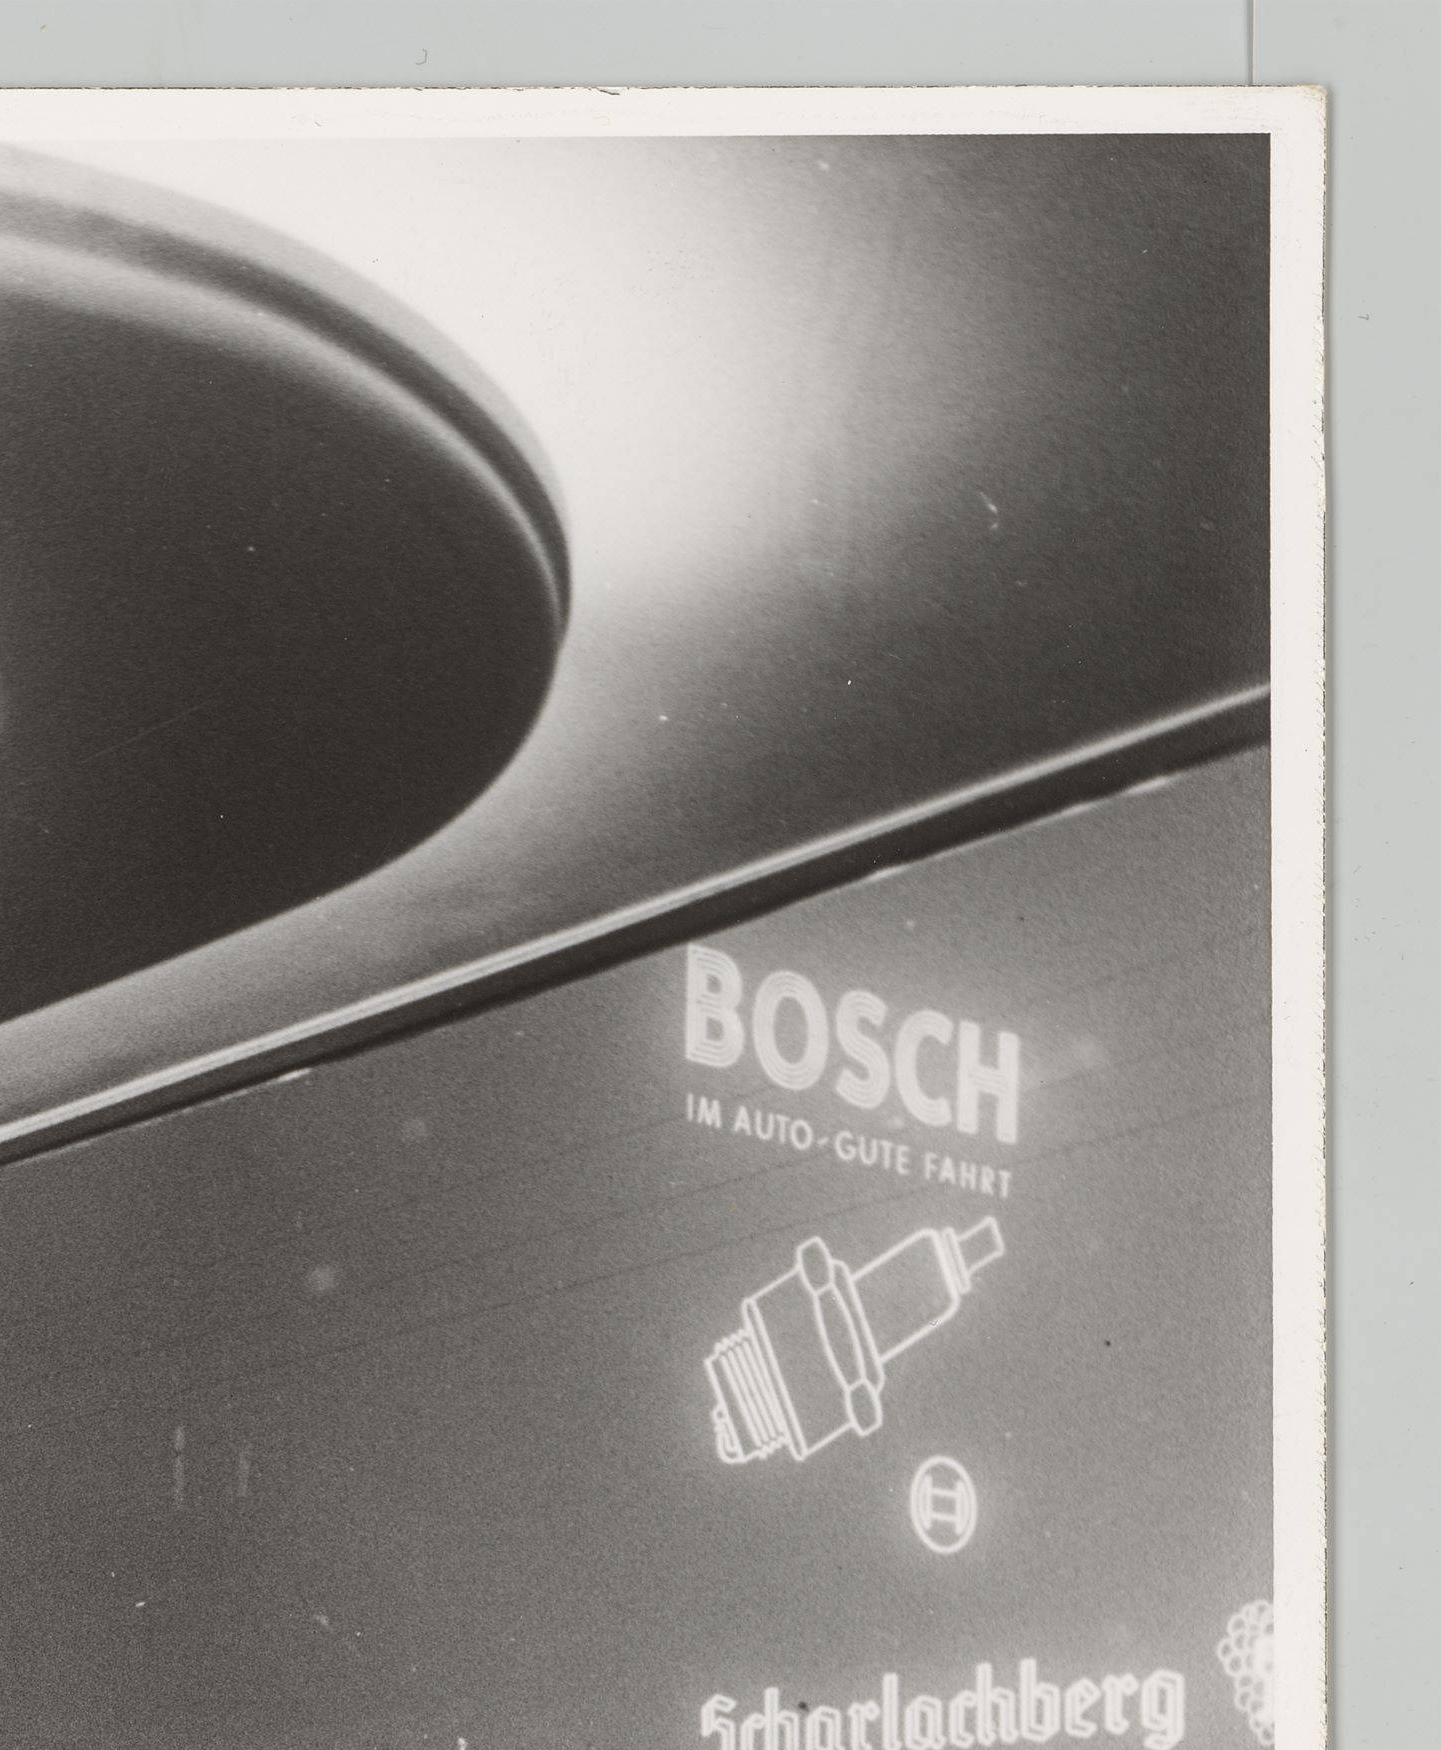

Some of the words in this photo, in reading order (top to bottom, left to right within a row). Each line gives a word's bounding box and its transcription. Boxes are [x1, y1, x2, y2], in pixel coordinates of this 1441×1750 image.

[685, 943, 1019, 1144] BOSCH
[687, 1093, 722, 1130] IM
[924, 1152, 1012, 1199] FAHRT
